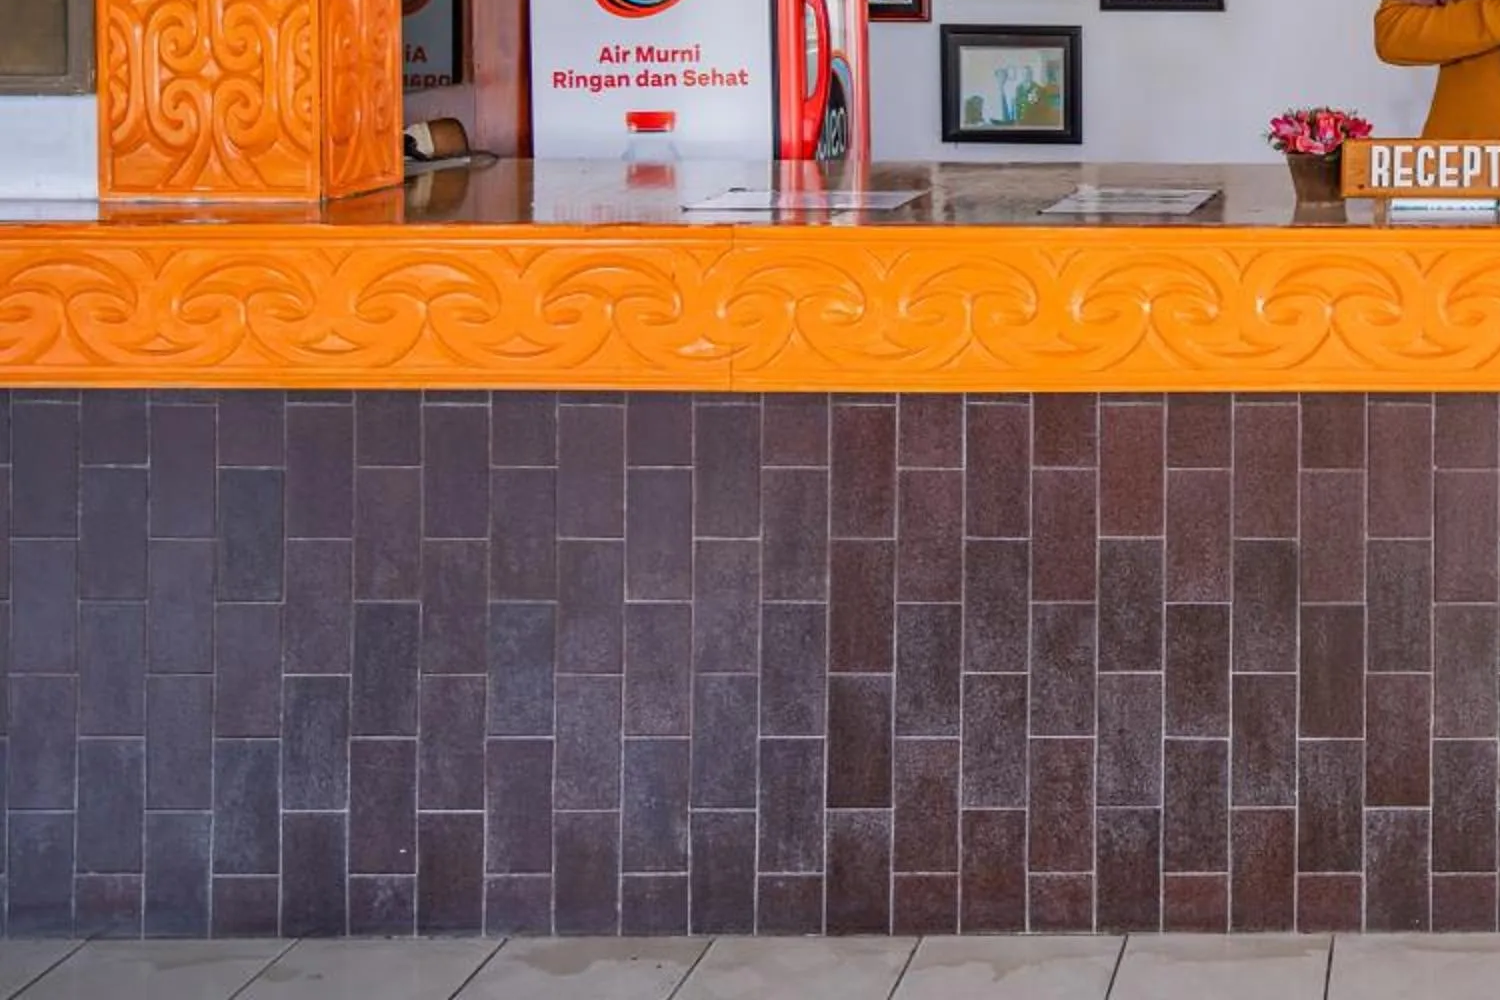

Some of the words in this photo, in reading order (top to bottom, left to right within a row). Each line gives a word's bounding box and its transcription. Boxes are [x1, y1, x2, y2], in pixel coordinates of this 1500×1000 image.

[599, 44, 631, 64] Air
[635, 44, 700, 64] Murni
[552, 70, 631, 92] Ringan
[635, 69, 678, 88] dan
[682, 68, 749, 88] Sehat
